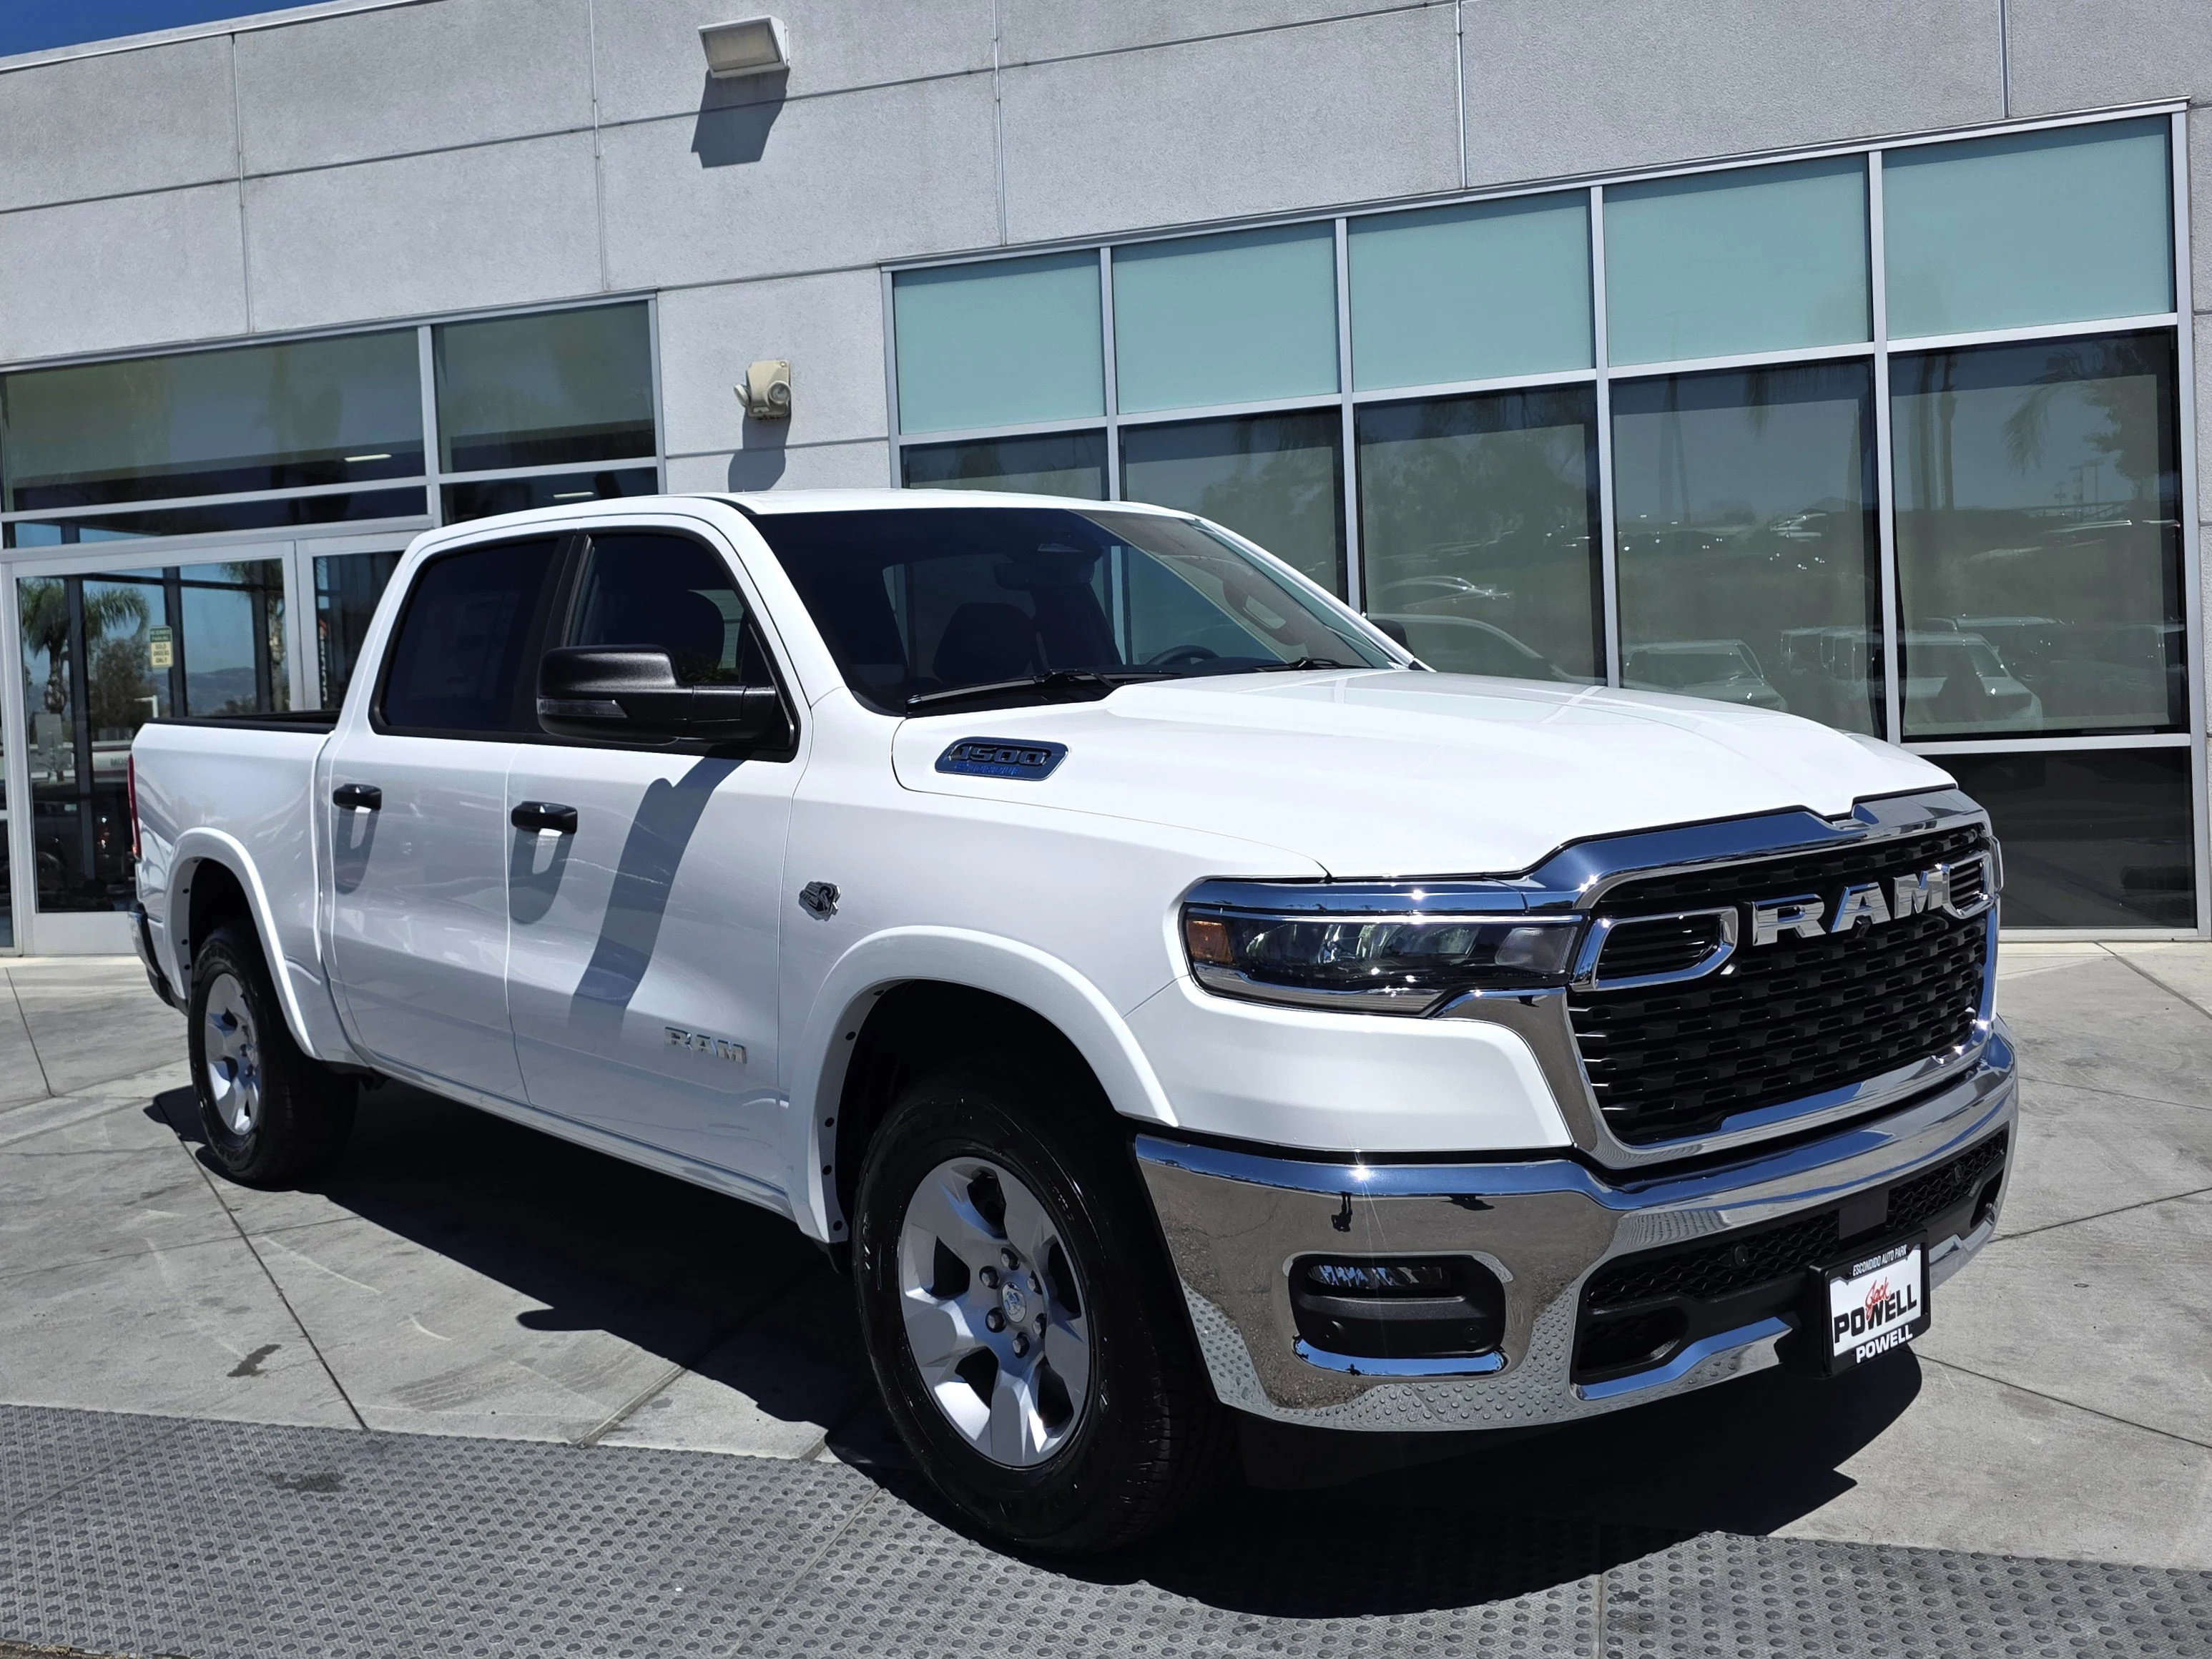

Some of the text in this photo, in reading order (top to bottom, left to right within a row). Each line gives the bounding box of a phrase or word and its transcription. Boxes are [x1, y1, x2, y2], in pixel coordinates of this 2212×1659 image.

[949, 746, 1047, 767] 1500
[1752, 864, 1950, 946] RAM
[664, 1026, 747, 1064] RAM
[1852, 1244, 1907, 1276] ESCONDIDO AUTO PARK
[1834, 1284, 1917, 1343] POWELL
[1865, 1276, 1892, 1321] Jack
[1855, 1324, 1913, 1364] POWELL
